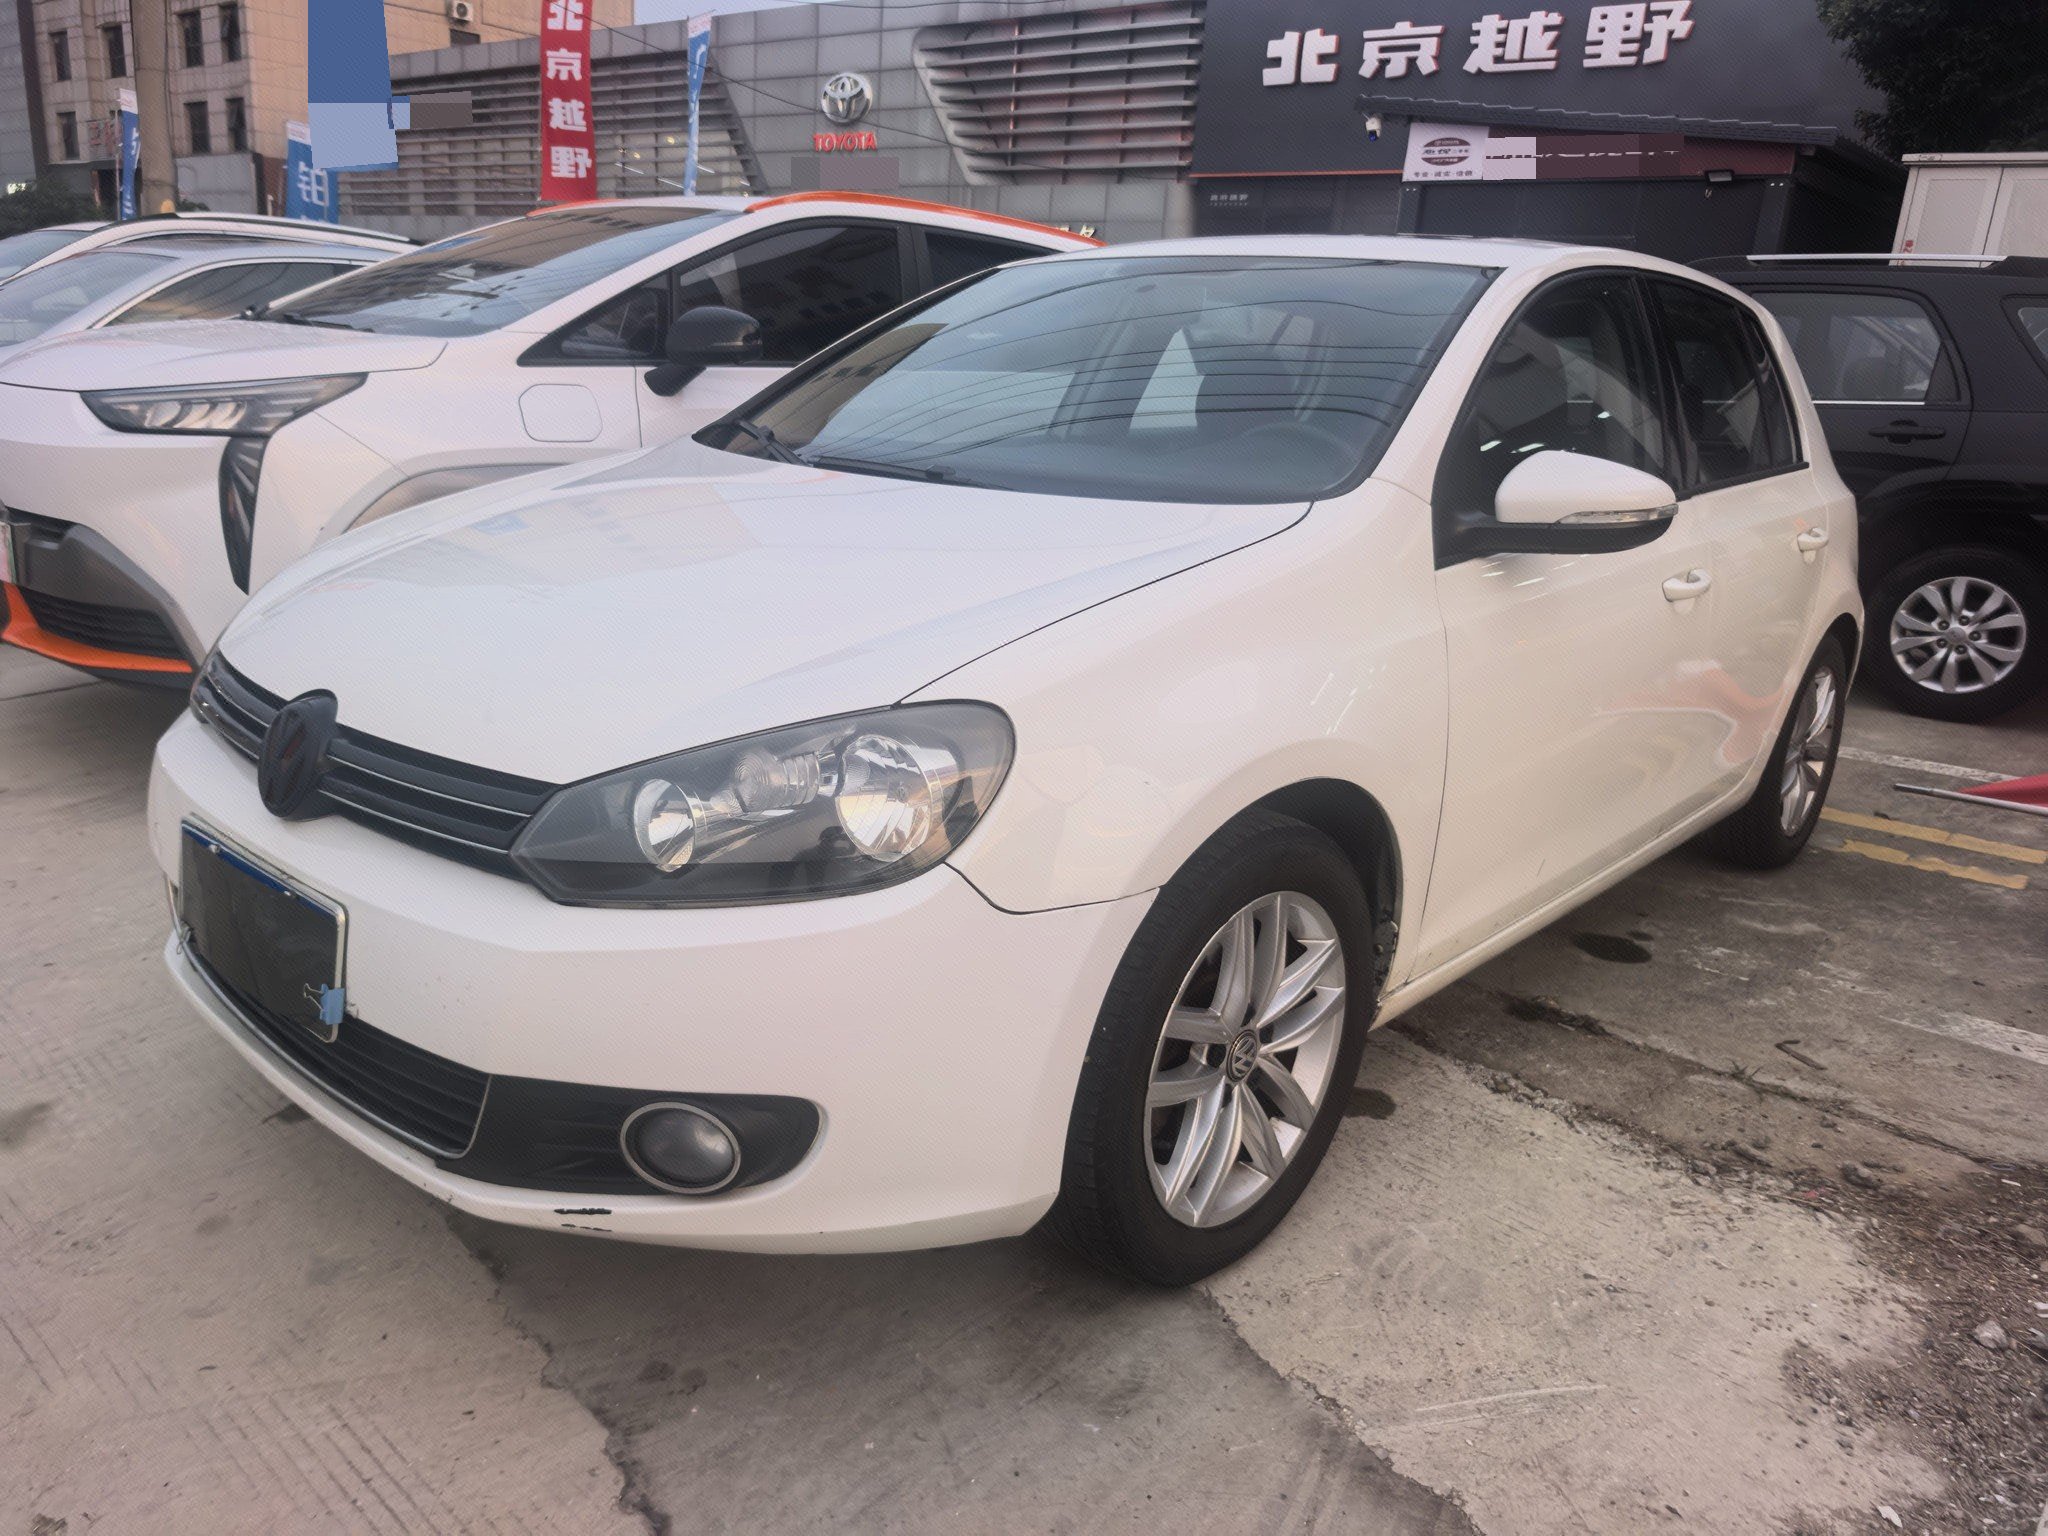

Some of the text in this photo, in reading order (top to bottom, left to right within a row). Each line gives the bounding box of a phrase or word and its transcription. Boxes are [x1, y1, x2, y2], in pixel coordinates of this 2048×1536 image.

[1262, 0, 1695, 87] 北京越野
[546, 0, 592, 179] 北京越野
[812, 130, 878, 152] TOYOTA
[296, 160, 330, 222] 铂
